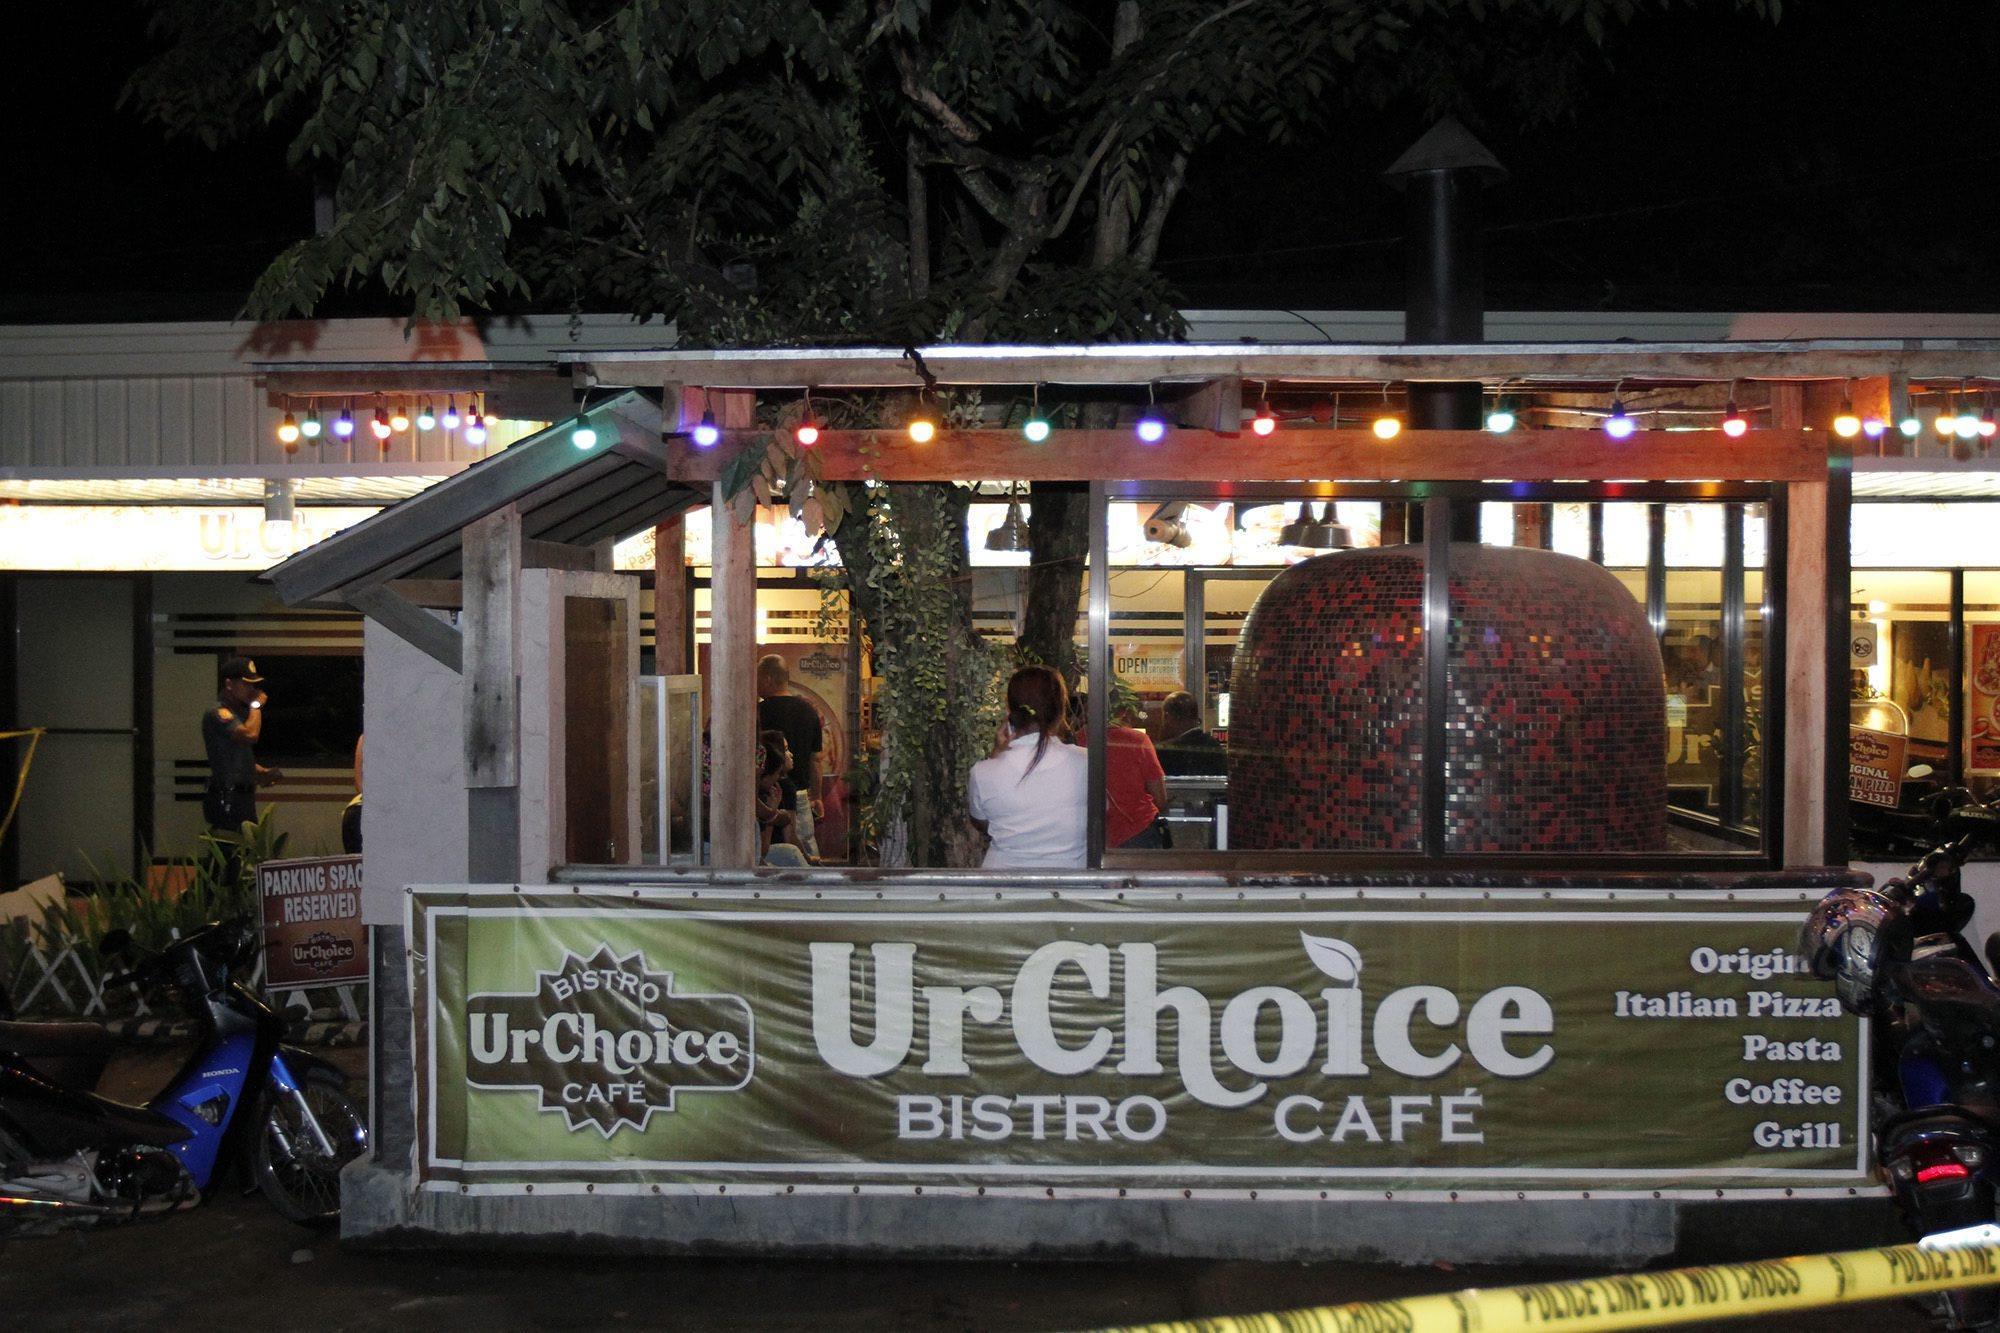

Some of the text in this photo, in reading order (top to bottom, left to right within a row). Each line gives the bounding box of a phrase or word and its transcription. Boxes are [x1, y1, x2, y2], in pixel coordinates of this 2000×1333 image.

[1118, 657, 1148, 674] OPEN
[1850, 741, 1889, 758] Choice
[1850, 764, 1889, 780] IGINAL
[1865, 777, 1896, 793] PIZZA
[1850, 789, 1895, 805] 12-1313
[264, 862, 363, 897] PARKING SPAC
[284, 892, 357, 923] RESERVED
[294, 944, 353, 961] UrChoice
[1690, 946, 1811, 980] Origin
[551, 969, 661, 1003] BISTRO
[1614, 990, 1843, 1018] Italian Pizza
[809, 930, 1556, 1108] UrChoice
[469, 1011, 740, 1076] UrChoice
[1742, 1034, 1842, 1062] Pasta
[202, 1067, 241, 1079] HONDA
[562, 1080, 647, 1104] CAFÉ
[1724, 1077, 1842, 1105] Coffee
[897, 1087, 1485, 1145] BISTRO CAFÉ
[1753, 1120, 1841, 1148] Grill
[1878, 1244, 1954, 1284] POLICE
[1513, 1261, 1801, 1321] POLICE LINE DO NOT CROSS
